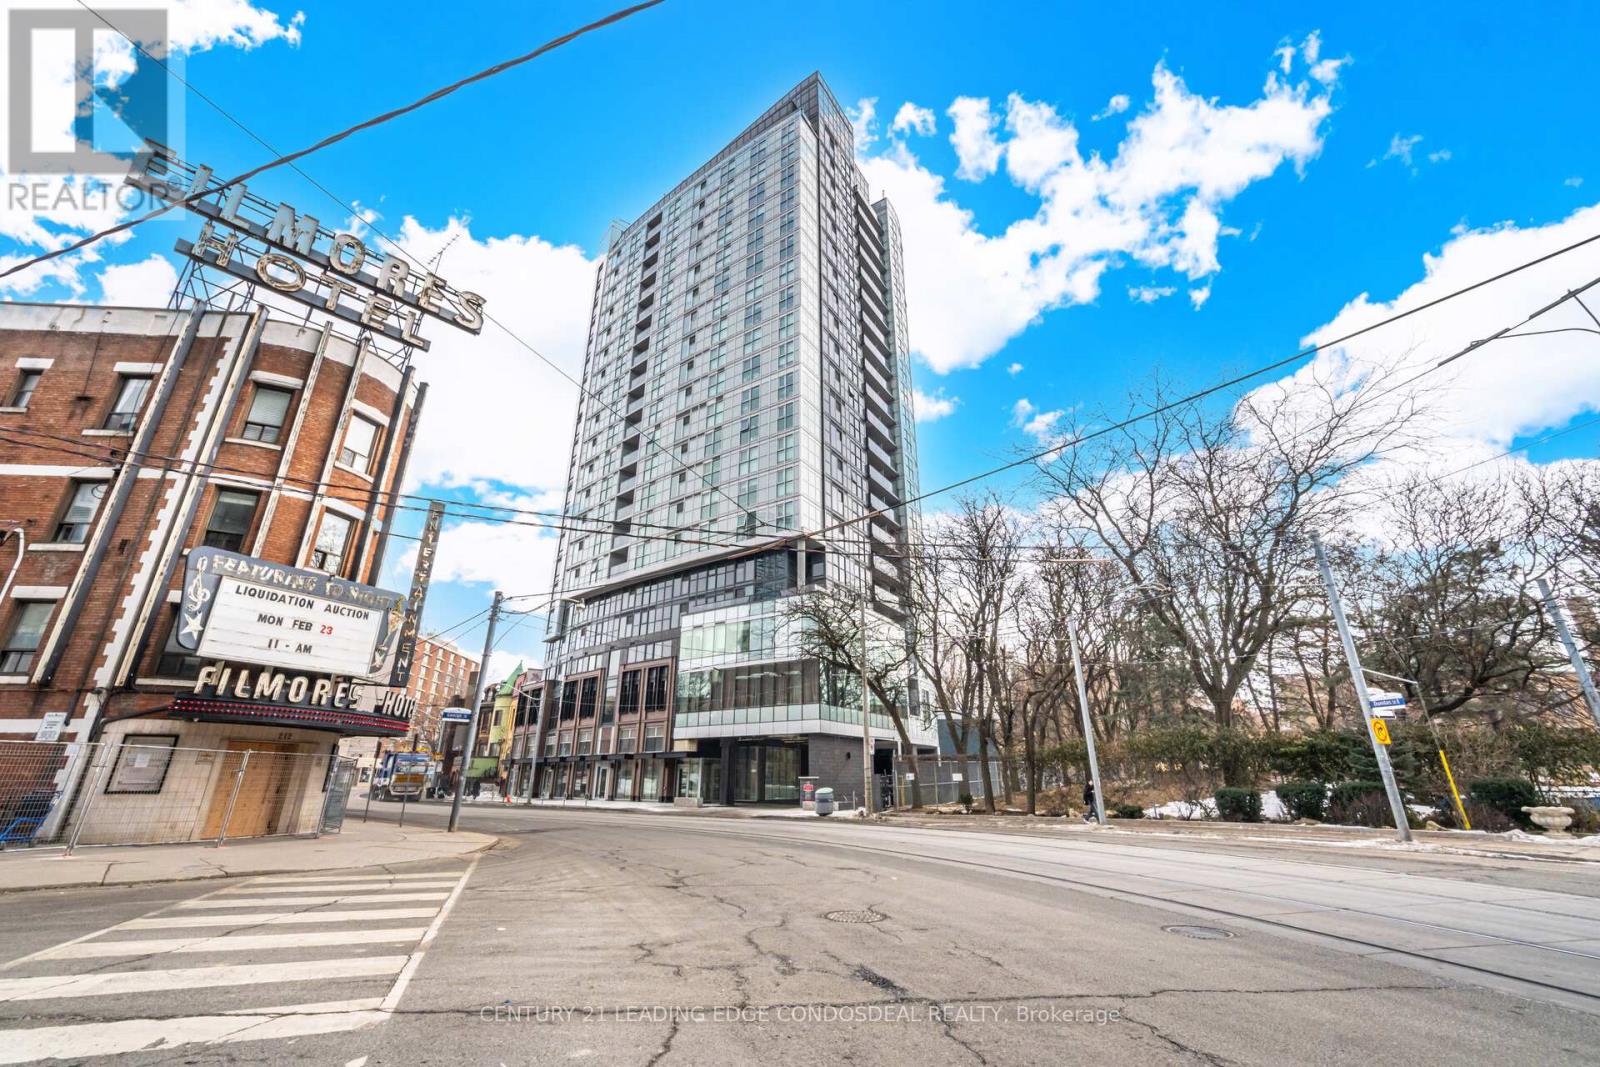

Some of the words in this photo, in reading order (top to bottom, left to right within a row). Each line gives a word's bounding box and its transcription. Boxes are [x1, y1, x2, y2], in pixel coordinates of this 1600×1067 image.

[191, 221, 425, 348] HOTEL
[212, 554, 318, 592] FEATURING
[235, 585, 314, 609] LIQUIDATION
[324, 604, 370, 620] AUCTION
[397, 510, 439, 682] ENTERTAINMENT
[257, 613, 284, 626] MON
[292, 619, 313, 631] FEB
[320, 624, 334, 635] 23
[268, 638, 279, 649] 11
[295, 643, 313, 654] AM
[193, 666, 364, 709] FILMORES
